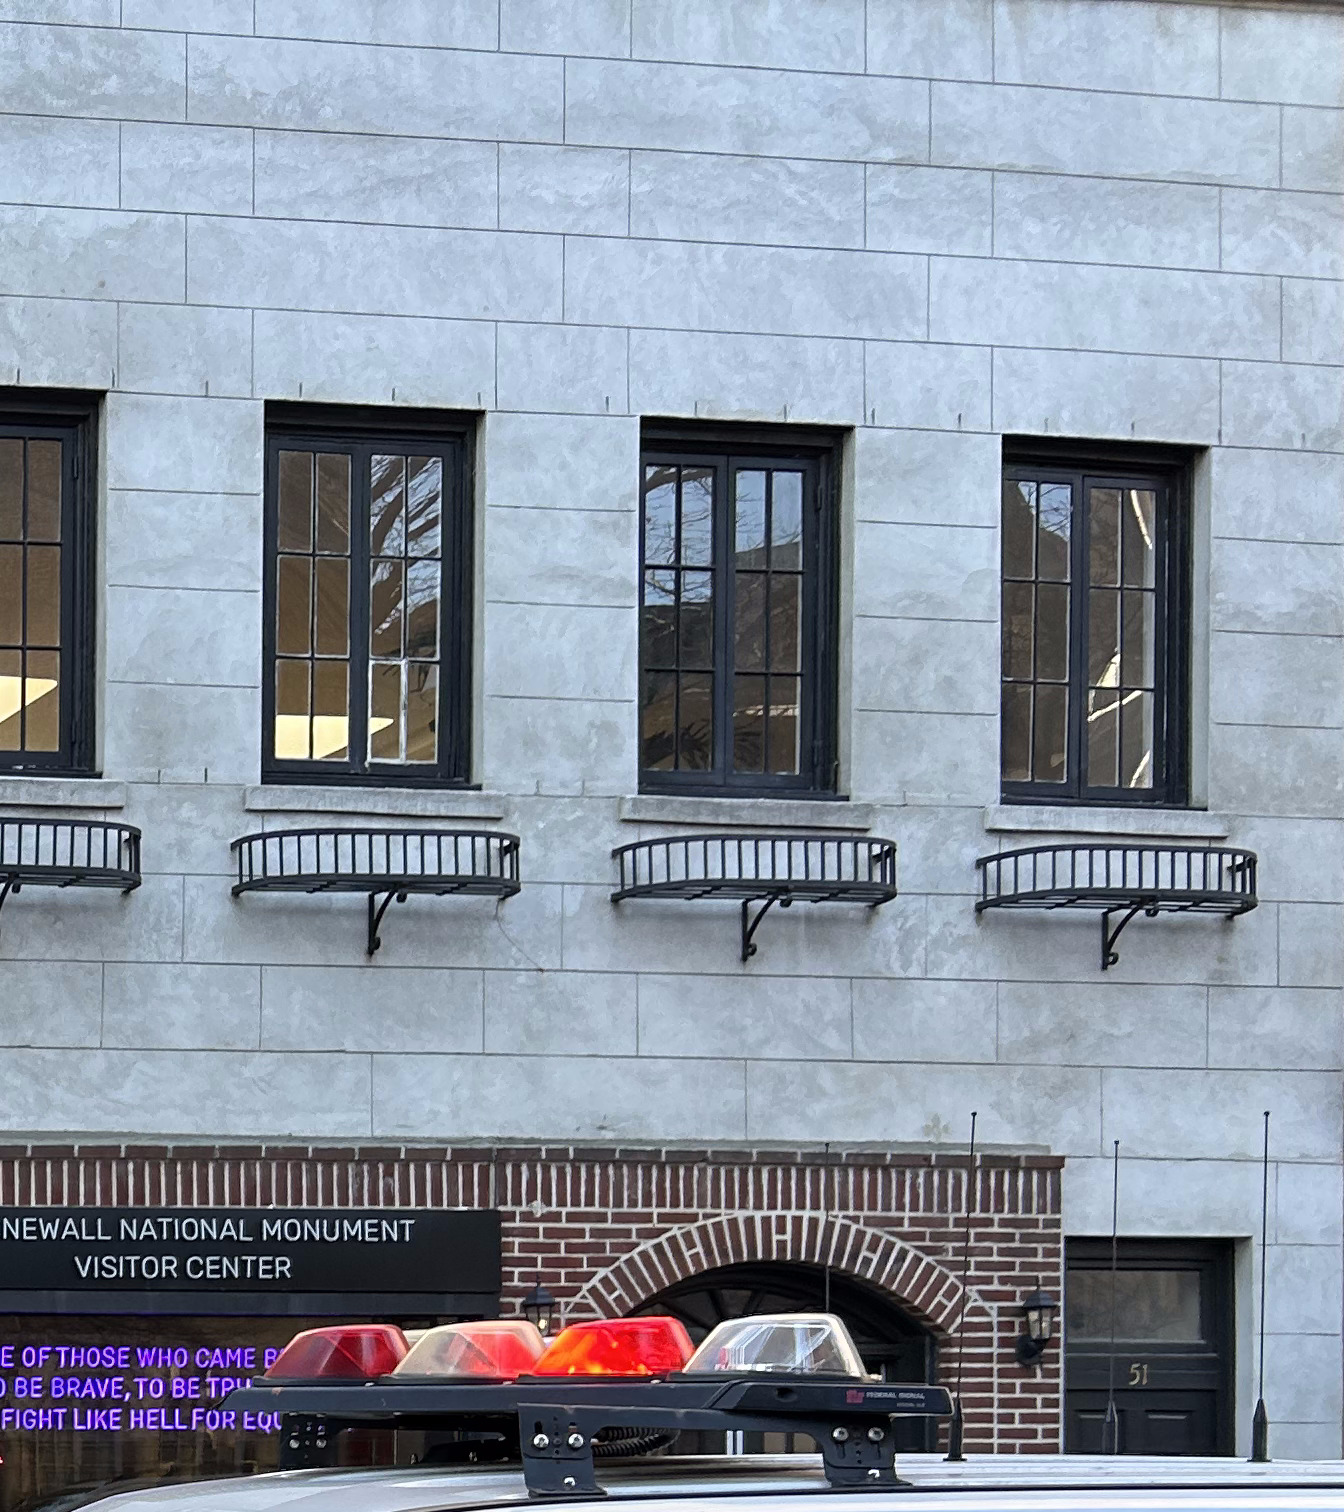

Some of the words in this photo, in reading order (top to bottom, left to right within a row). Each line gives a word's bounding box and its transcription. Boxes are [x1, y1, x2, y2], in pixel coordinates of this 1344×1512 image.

[120, 1217, 254, 1241] NATIONAL
[263, 1218, 415, 1242] MONUMENT
[74, 1255, 178, 1279] VISITOR
[186, 1256, 291, 1279] CENTER
[21, 1346, 53, 1368] OF
[53, 1346, 130, 1368] THOSE
[137, 1347, 188, 1369] WHO
[195, 1347, 256, 1369] CAME
[1128, 1362, 1149, 1386] 51
[14, 1376, 43, 1398] BE
[50, 1376, 131, 1402] BRAVE,
[133, 1376, 165, 1399] TO
[172, 1377, 200, 1399] BE
[1, 1408, 67, 1430] FIGHT
[73, 1408, 122, 1430] LIKE
[129, 1408, 188, 1430] HELL
[191, 1408, 236, 1431] FOR
